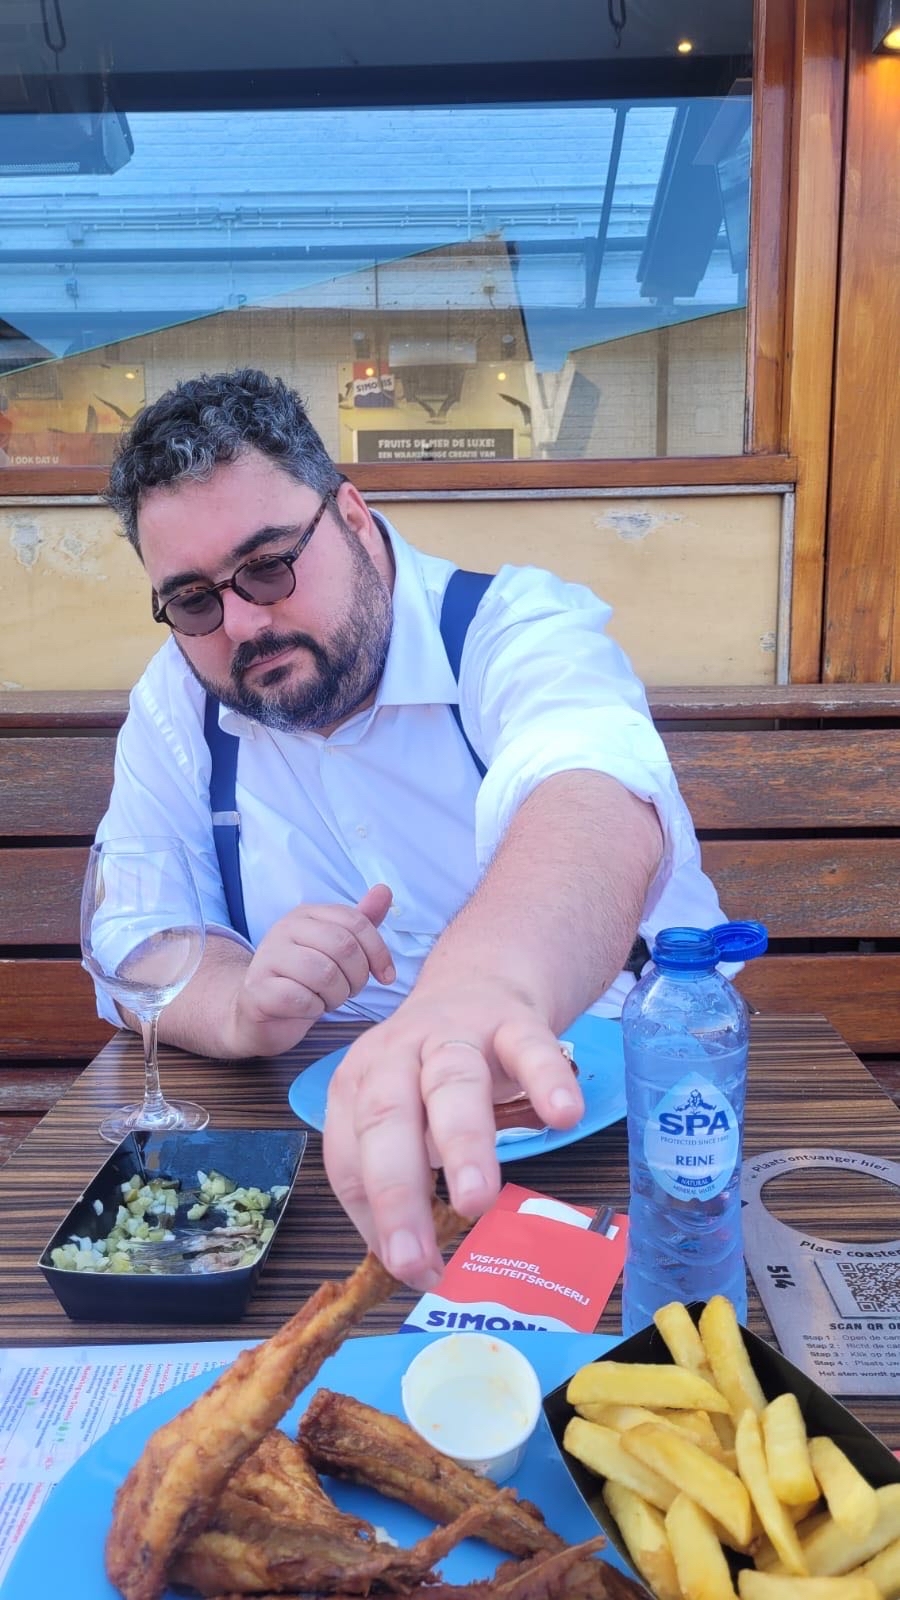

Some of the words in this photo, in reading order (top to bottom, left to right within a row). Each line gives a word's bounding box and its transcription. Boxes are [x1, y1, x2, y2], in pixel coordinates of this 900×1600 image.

[378, 440, 411, 448] FRUITS
[430, 440, 449, 448] MER
[467, 439, 495, 447] LUXE!
[658, 1111, 730, 1136] SPA
[660, 1136, 697, 1145] PROTECTED
[676, 1155, 715, 1166] REINE
[752, 1159, 786, 1172] Plaats
[788, 1155, 858, 1163] ontvanger
[859, 1160, 890, 1171] hier
[800, 1240, 841, 1255] Place
[469, 1252, 541, 1274] VISHANDEL
[461, 1261, 591, 1306] KWALITEITSROKERIJ
[426, 1310, 548, 1332] SIMON
[867, 1323, 884, 1331] QR
